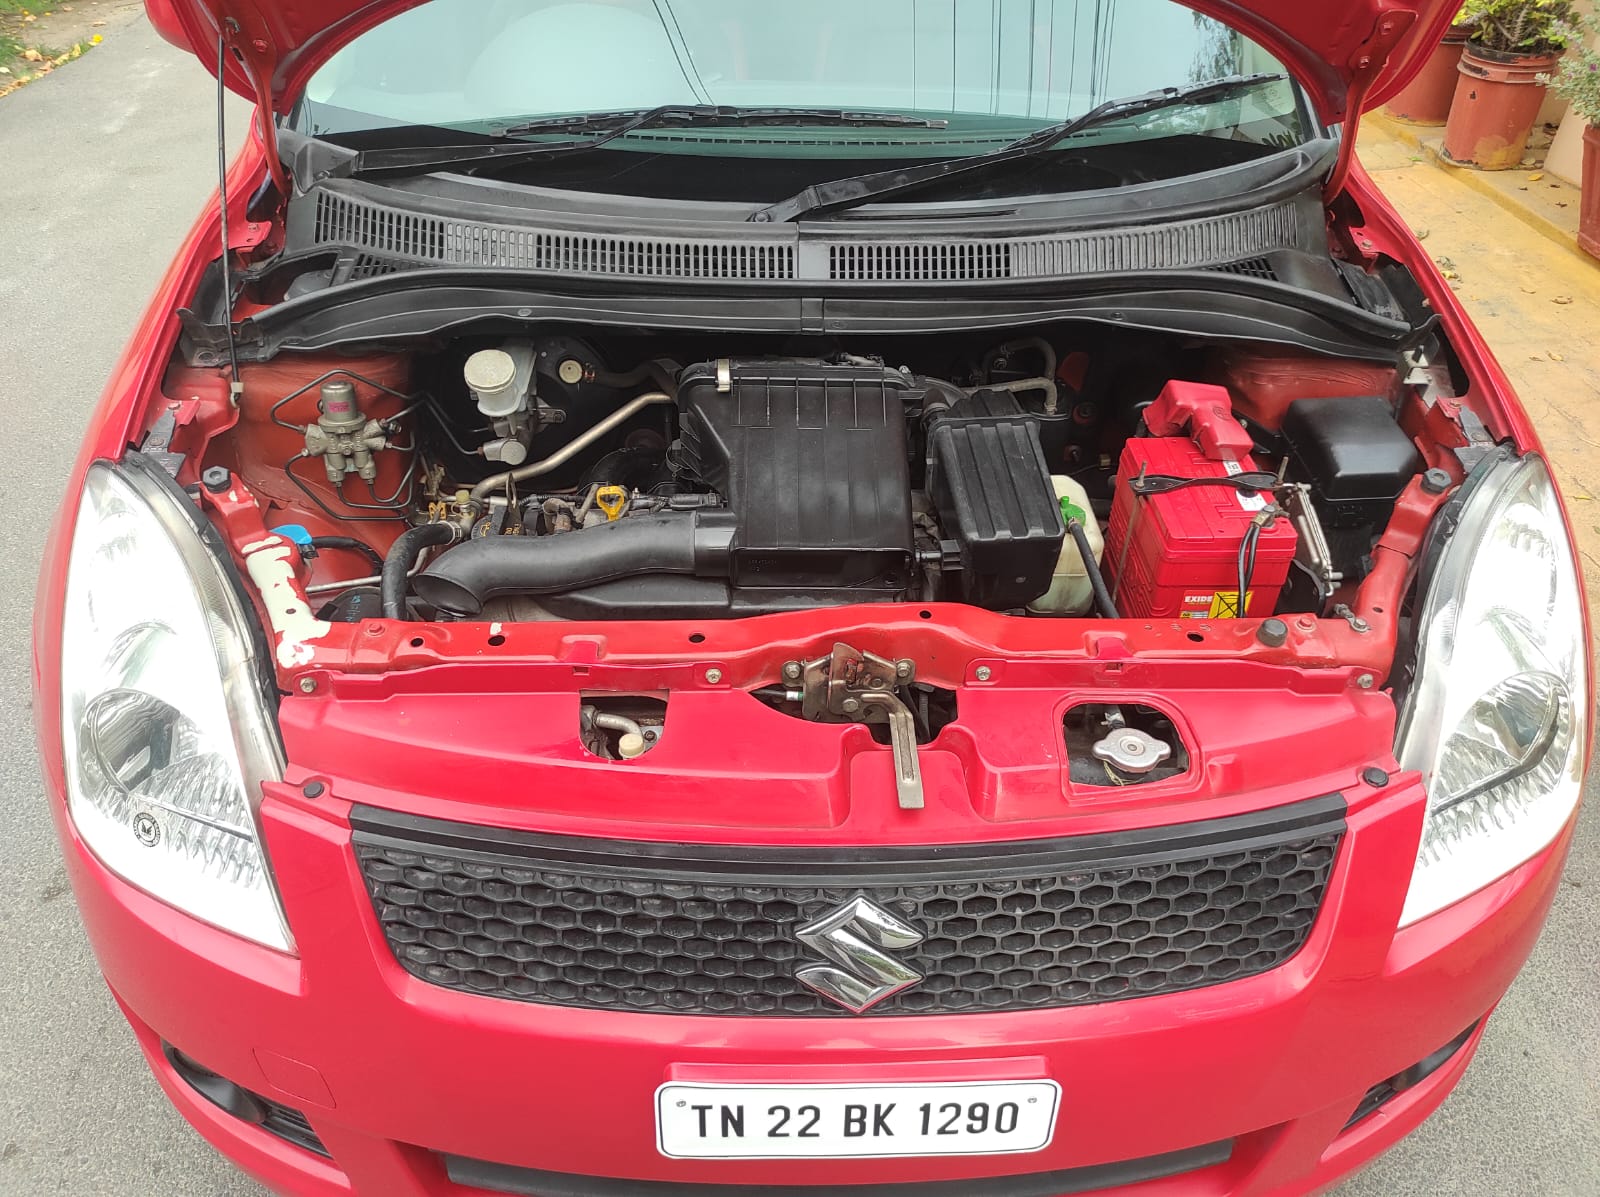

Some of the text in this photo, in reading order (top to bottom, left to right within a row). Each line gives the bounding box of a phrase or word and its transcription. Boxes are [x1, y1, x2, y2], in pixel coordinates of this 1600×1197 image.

[1184, 595, 1213, 603] EXIDE
[691, 1102, 1019, 1138] TN 22 BK 1290
